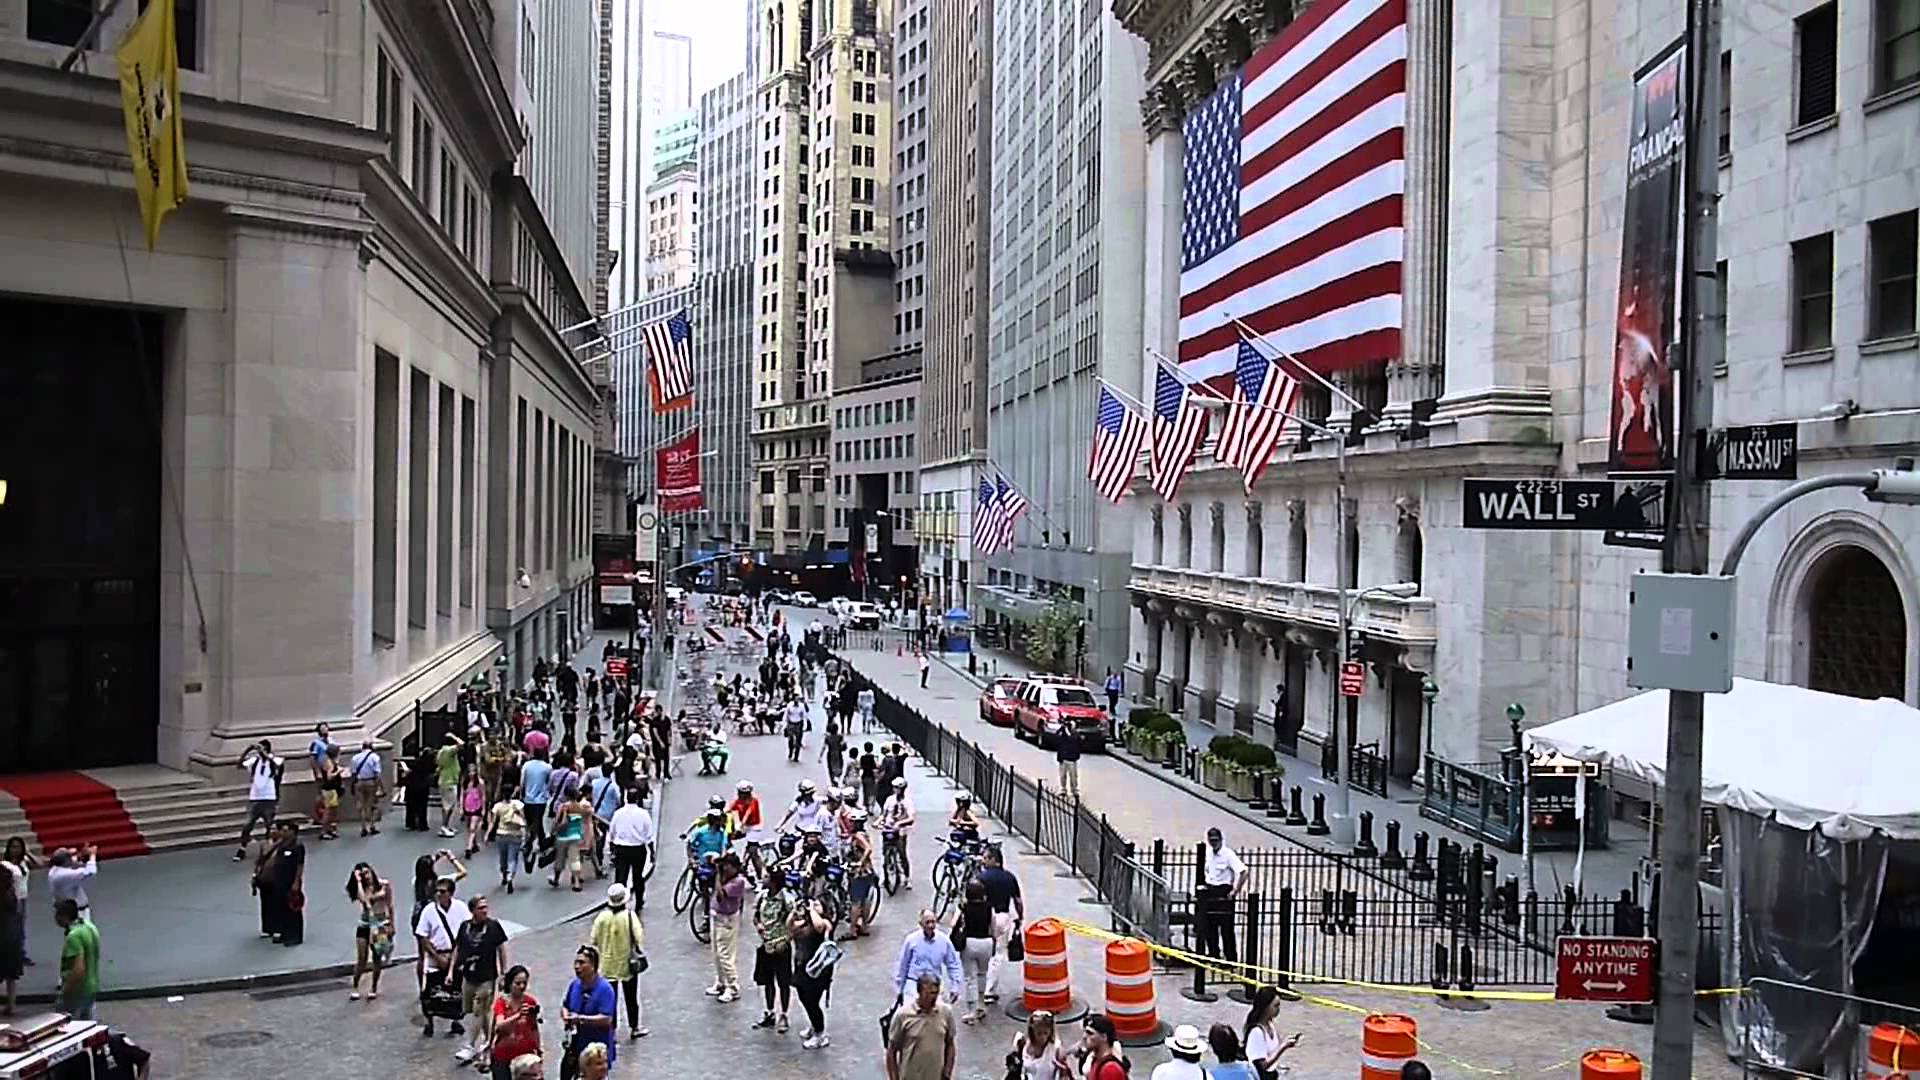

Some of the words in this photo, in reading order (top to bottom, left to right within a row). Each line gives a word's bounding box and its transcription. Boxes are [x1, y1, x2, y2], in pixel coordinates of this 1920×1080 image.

[1728, 439, 1781, 470] NASSAU
[1783, 438, 1793, 456] ST
[1527, 481, 1563, 493] 22-51
[1478, 492, 1576, 520] WALL
[1576, 493, 1600, 508] ST
[1562, 943, 1581, 957] NO
[1586, 943, 1649, 959] STANDING
[1571, 961, 1638, 976] ANYTIME
